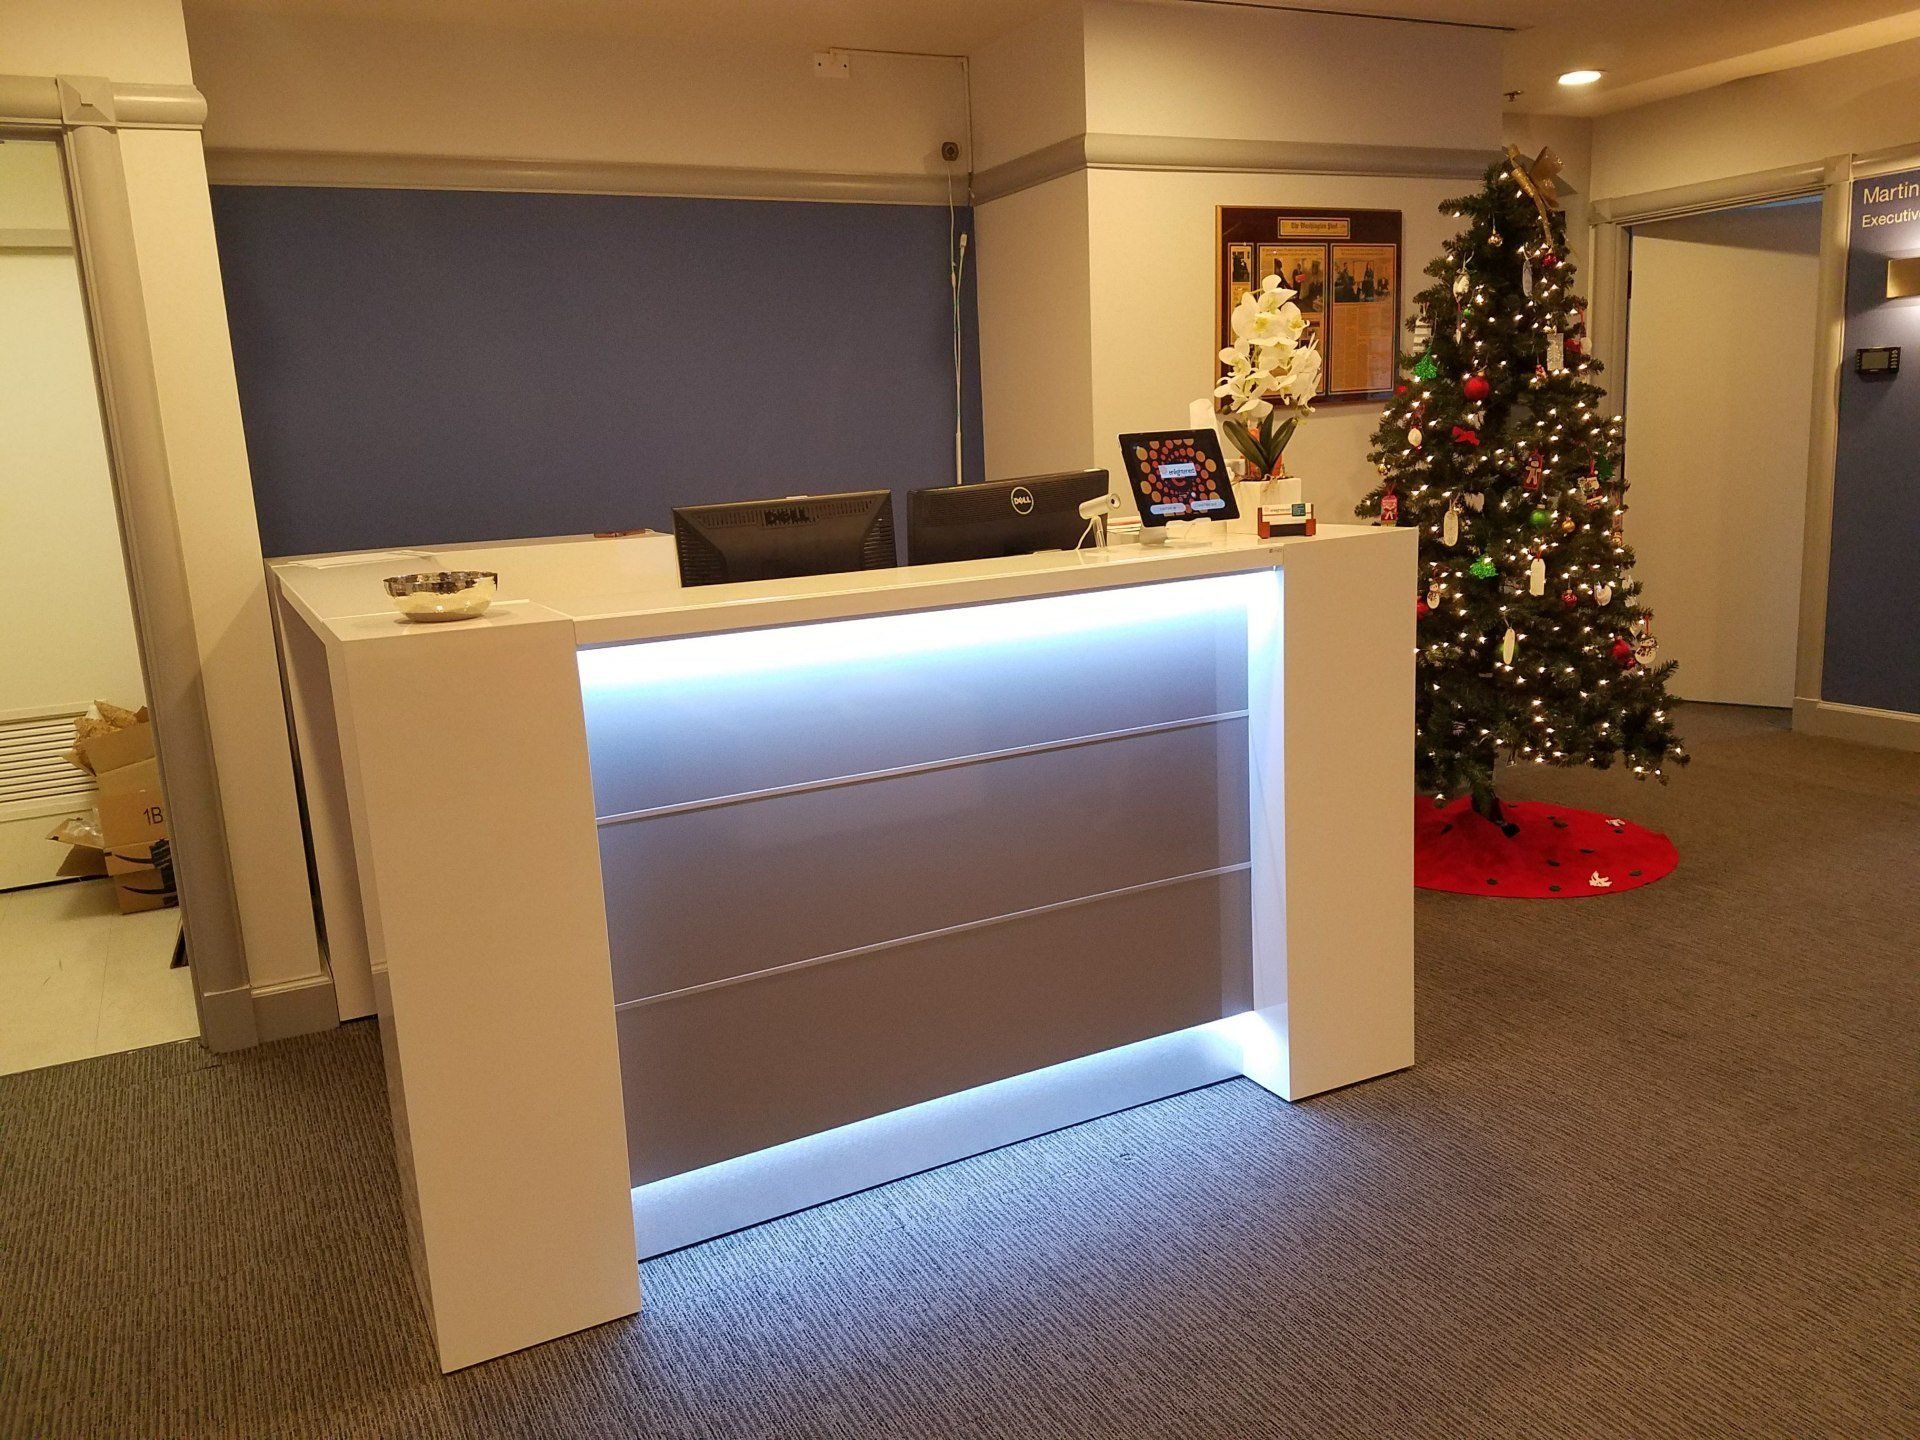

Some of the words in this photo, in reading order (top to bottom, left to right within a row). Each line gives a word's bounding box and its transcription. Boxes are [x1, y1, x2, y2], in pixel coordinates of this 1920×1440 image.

[1863, 181, 1919, 205] Martin
[1862, 208, 1920, 229] Executiv
[1013, 496, 1031, 505] DELL
[764, 509, 809, 526] DELL
[142, 806, 164, 826] 1B
